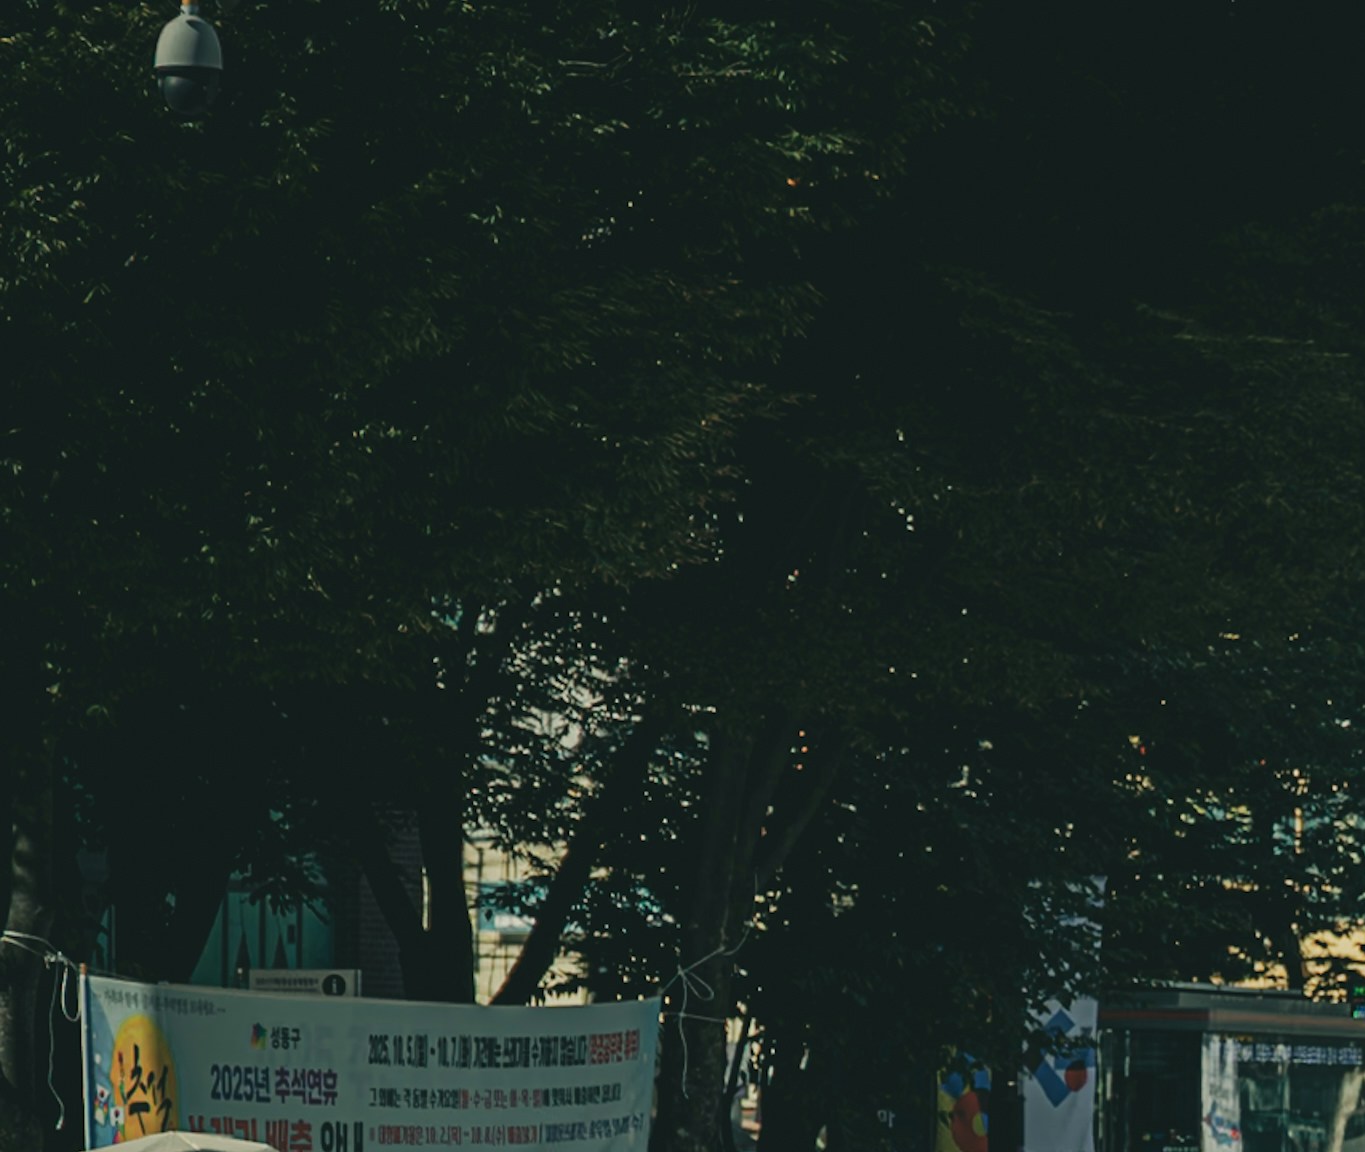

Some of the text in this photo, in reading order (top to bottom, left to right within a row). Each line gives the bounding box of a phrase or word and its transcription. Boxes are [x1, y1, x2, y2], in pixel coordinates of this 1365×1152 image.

[270, 1027, 301, 1050] 성동구
[211, 1064, 338, 1106] 2025년 추석연휴
